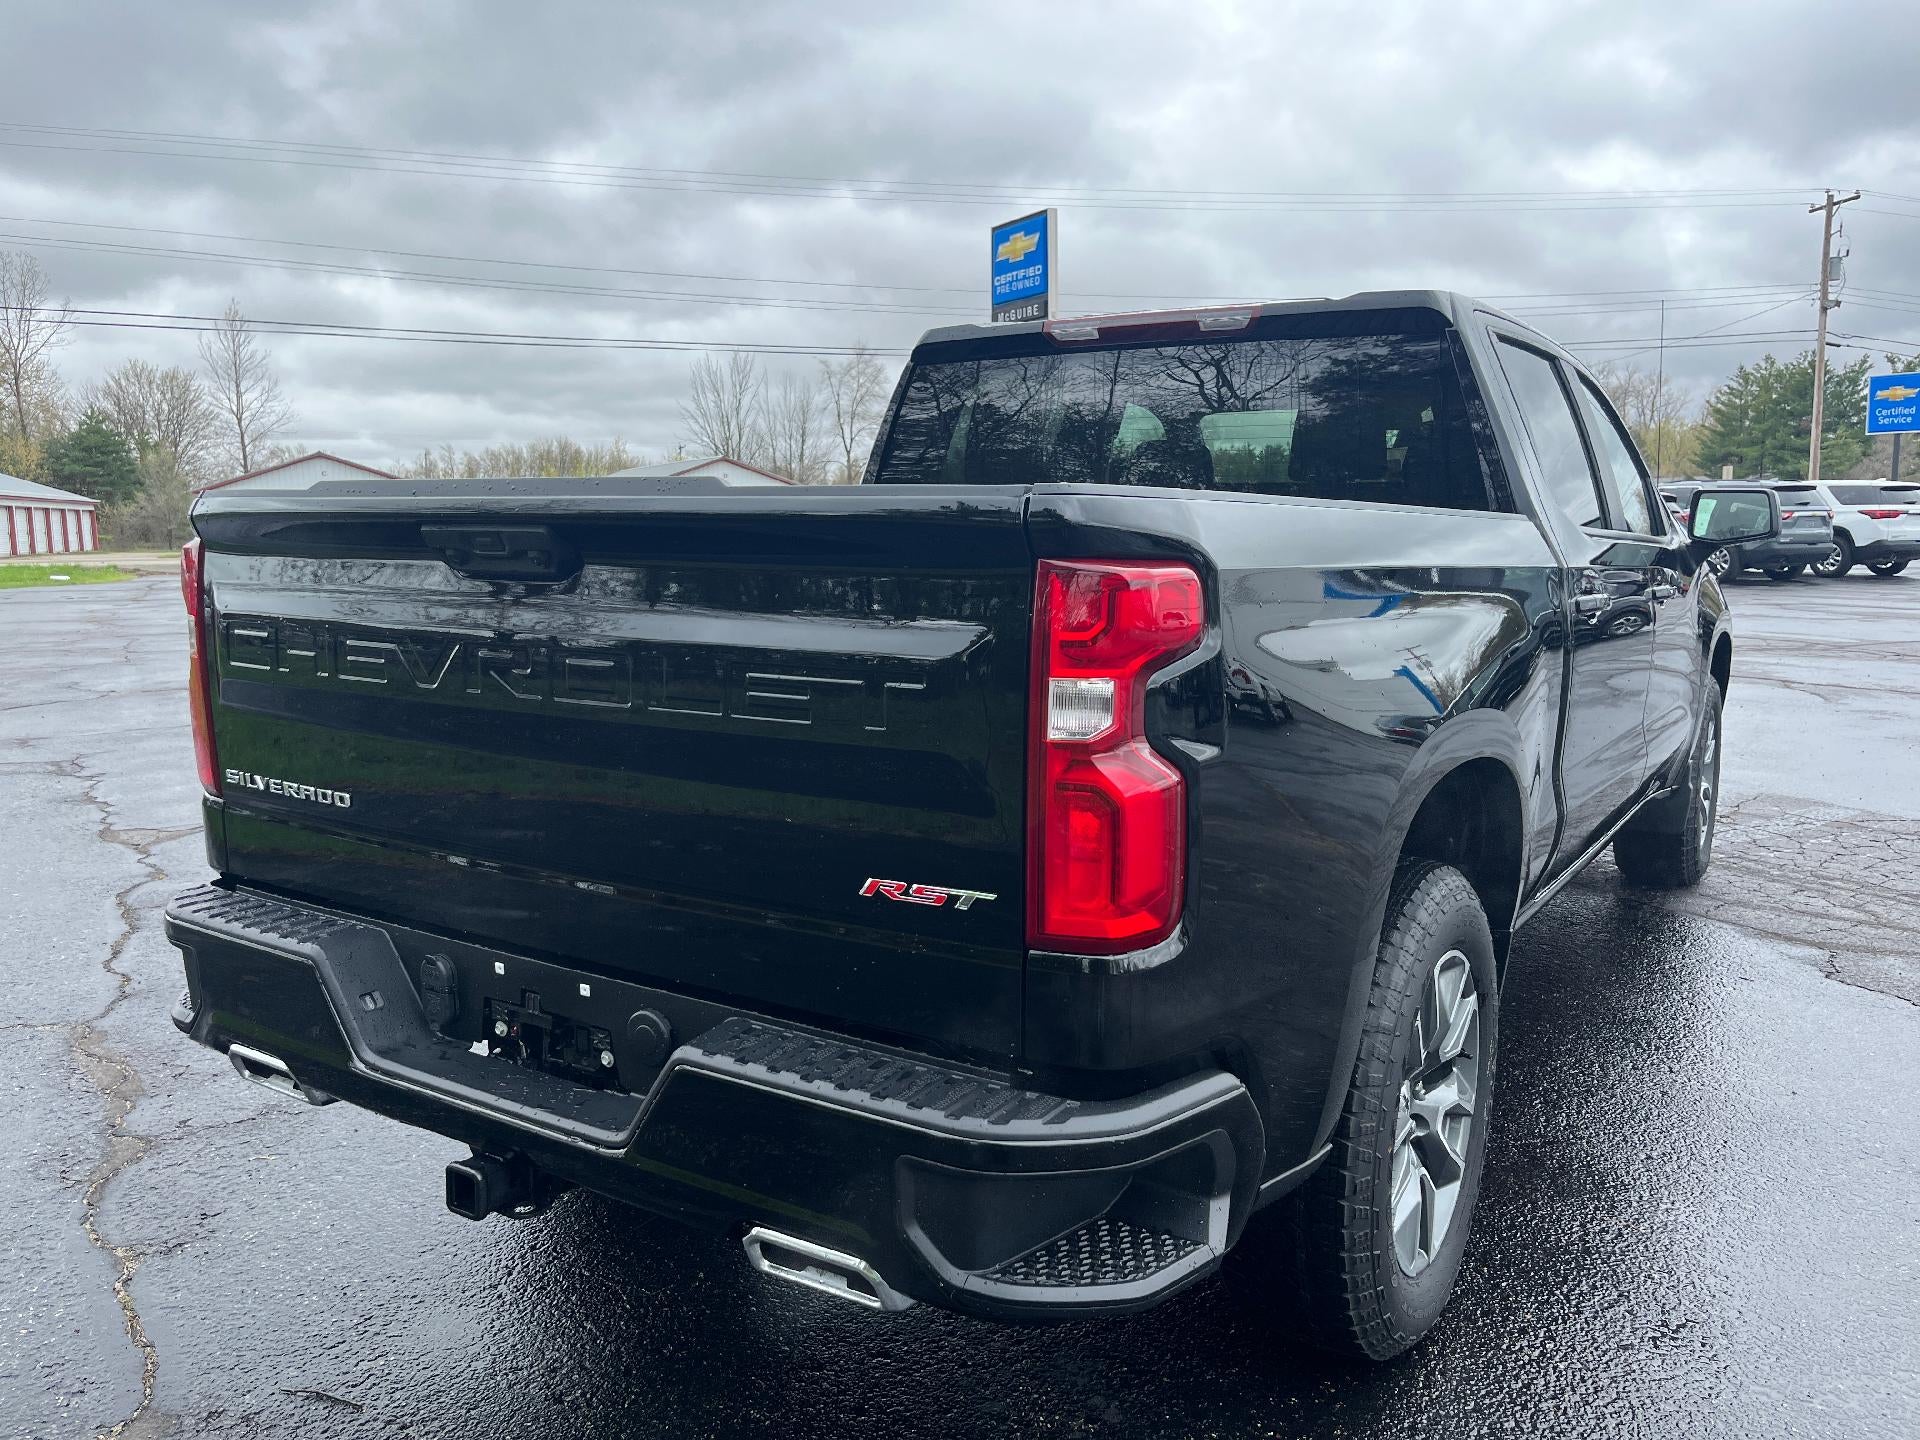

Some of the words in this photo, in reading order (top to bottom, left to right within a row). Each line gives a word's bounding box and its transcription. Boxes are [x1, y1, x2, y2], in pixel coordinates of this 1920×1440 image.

[994, 265, 1043, 286] CERTIFIED
[996, 276, 1041, 295] PRE-OWNED
[1875, 406, 1916, 416] Certified
[1878, 416, 1912, 425] Service
[226, 621, 927, 732] CHEVROLET
[225, 768, 351, 808] SILVERADO
[859, 877, 998, 911] RST
